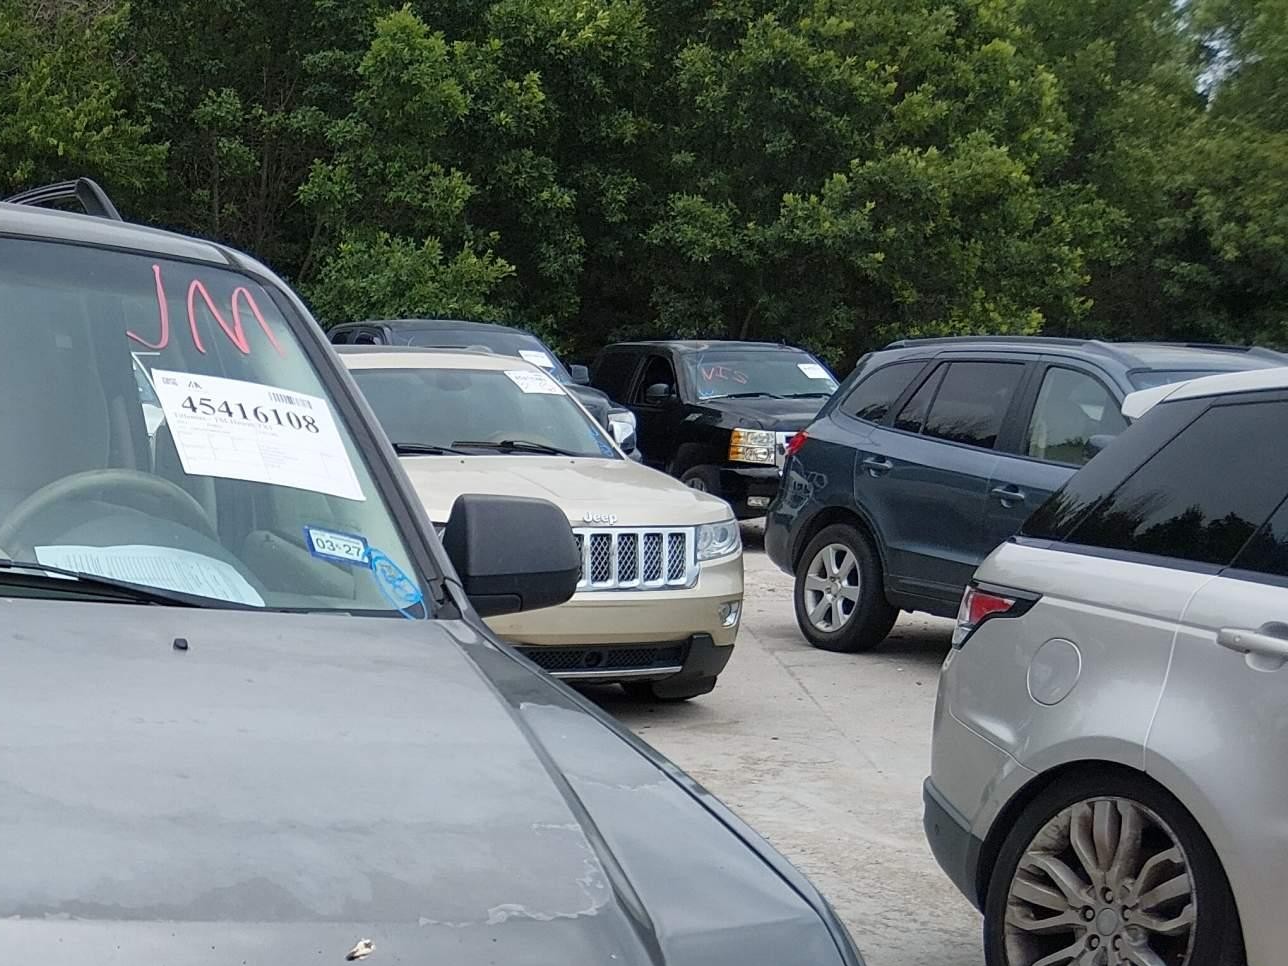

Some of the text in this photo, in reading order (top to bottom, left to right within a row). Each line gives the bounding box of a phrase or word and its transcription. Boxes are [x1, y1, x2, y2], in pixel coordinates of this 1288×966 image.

[126, 264, 287, 358] JM
[181, 395, 320, 434] 45416108
[583, 511, 617, 525] Jeep
